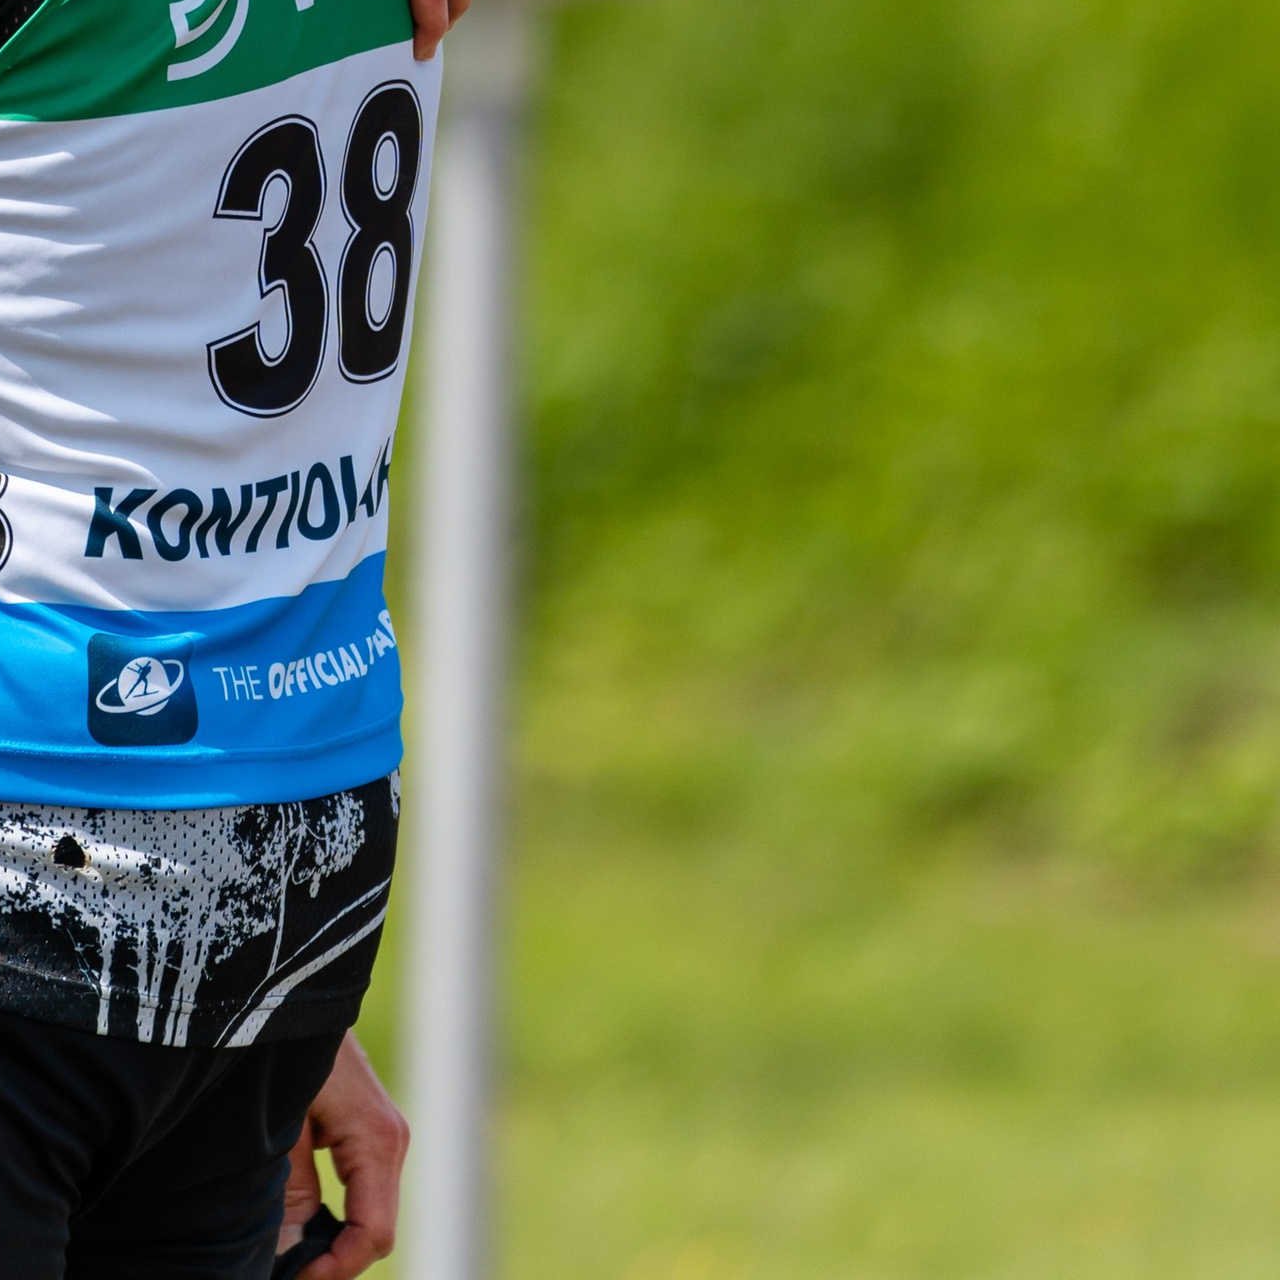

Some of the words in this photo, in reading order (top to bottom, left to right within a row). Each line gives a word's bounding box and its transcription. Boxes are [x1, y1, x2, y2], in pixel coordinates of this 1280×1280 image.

[206, 79, 422, 418] 38
[212, 665, 264, 701] THE
[268, 643, 368, 700] OFFICIAL
